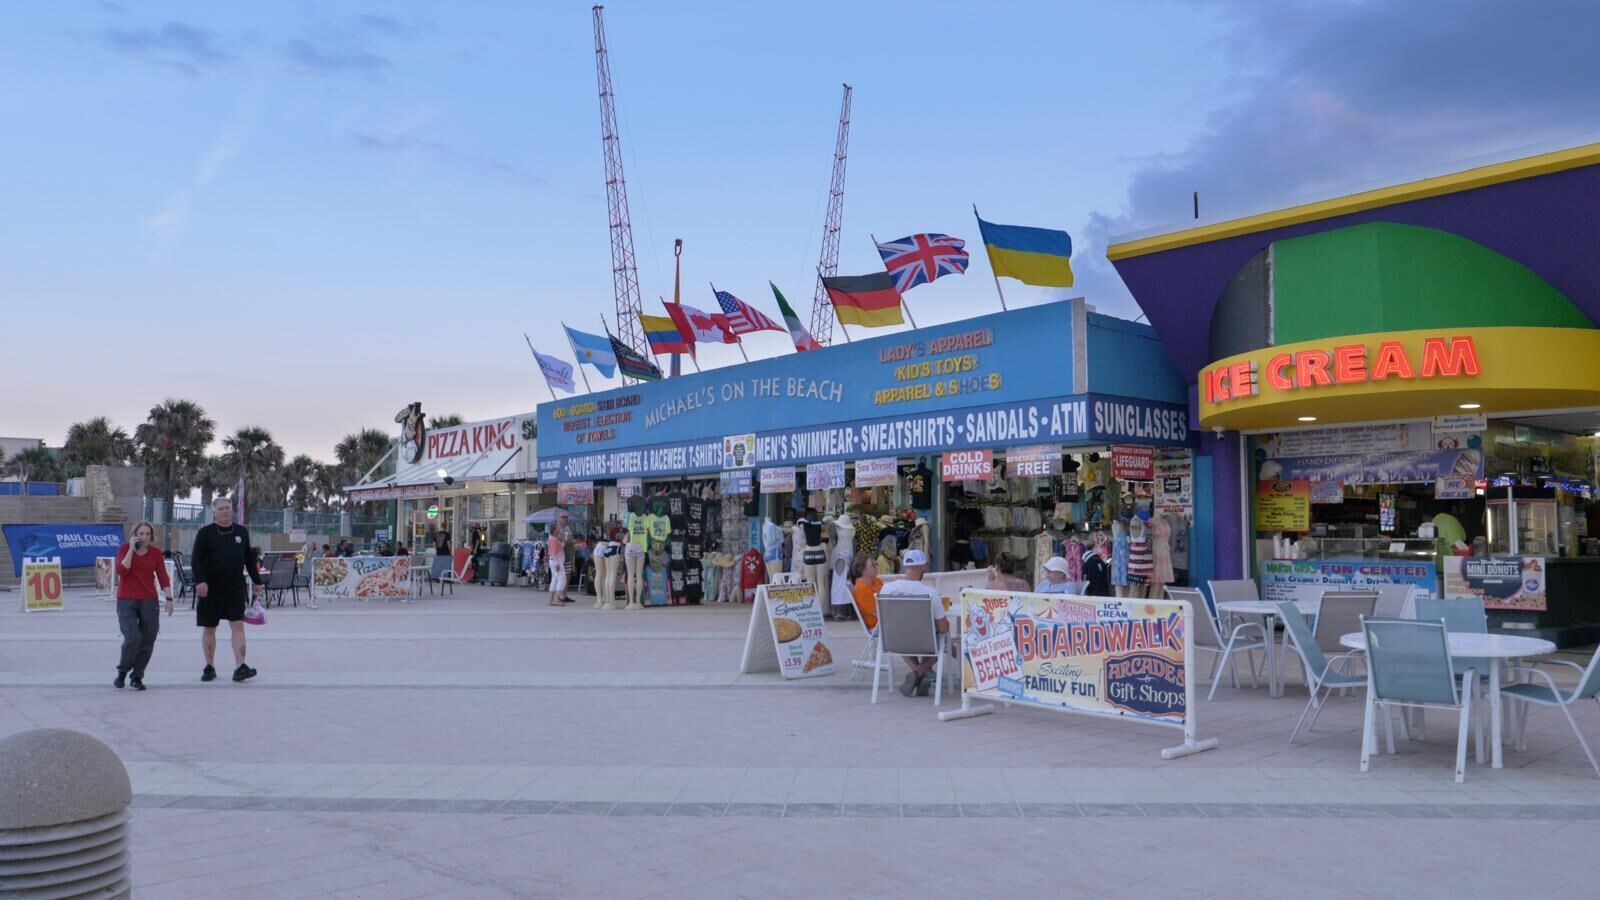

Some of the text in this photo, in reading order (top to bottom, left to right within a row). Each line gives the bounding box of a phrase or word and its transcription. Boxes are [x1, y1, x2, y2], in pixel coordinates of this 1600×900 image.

[929, 330, 993, 355] APPAREL
[896, 355, 974, 382] KID'S TOYS
[1205, 336, 1481, 403] ICE CREAM
[874, 374, 1002, 405] APPAREL & SHOES
[645, 377, 844, 430] MICHAEL'S ON THE BEACH
[1094, 401, 1186, 441] SUNGLASSES
[428, 421, 515, 459] PIZZA KING
[568, 454, 607, 477] SOUVENIRS
[610, 451, 642, 474] BIKEWEEK
[643, 453, 649, 470] &
[650, 447, 687, 471] RACEWEEK
[688, 442, 723, 468] T-SHIRTS
[756, 435, 788, 462] MEN'S
[791, 427, 853, 459] SWIMWEAR
[861, 416, 955, 452] SWEATSHIRTS
[966, 406, 1039, 443] SANDALS
[1051, 401, 1087, 435] ATM
[950, 451, 984, 464] COLD
[1115, 455, 1150, 468] LIFEGUARD
[943, 462, 991, 476] DRINKS
[1017, 461, 1050, 475] FREE
[56, 534, 120, 543] PAUL CULVER
[353, 559, 385, 576] Pizza
[1320, 565, 1353, 575] FUN
[1359, 565, 1428, 576] CENTER
[1466, 565, 1519, 575] MINI DONUTS
[322, 586, 350, 598] Salads
[775, 600, 814, 616] Special
[983, 598, 1008, 611] RIDES
[1097, 610, 1128, 618] CREAM
[970, 636, 1013, 658] World Famous
[1014, 614, 1184, 662] BOARDWALK
[976, 650, 1018, 683] BEACH
[1037, 661, 1083, 679] Exciting
[1108, 658, 1185, 687] ARCADES
[1025, 675, 1066, 695] FAMILY
[1110, 682, 1185, 708] Gift Shops
